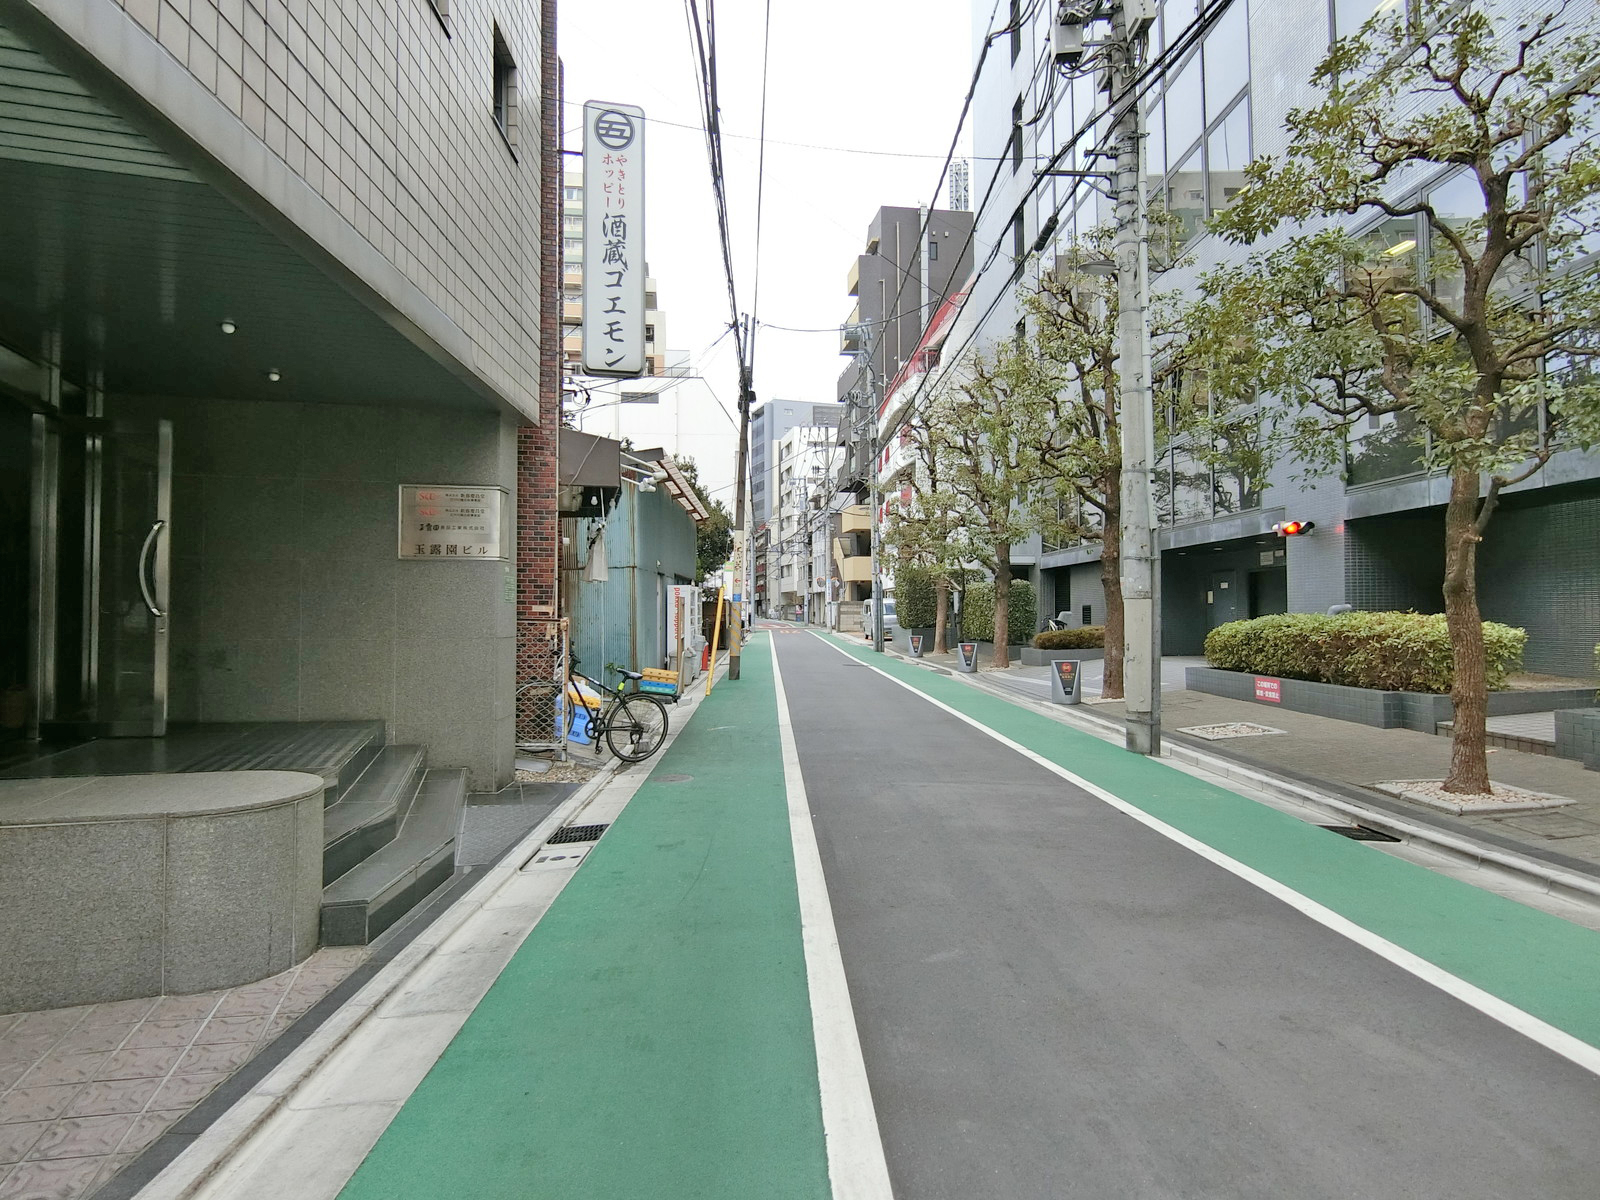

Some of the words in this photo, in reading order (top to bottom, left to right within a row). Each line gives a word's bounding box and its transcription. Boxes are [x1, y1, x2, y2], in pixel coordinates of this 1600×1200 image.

[602, 153, 614, 209] ホッピー
[616, 155, 628, 210] やきとり
[602, 213, 629, 368] 酒蔵ゴエモン
[413, 543, 489, 556] 玉露園ビル
